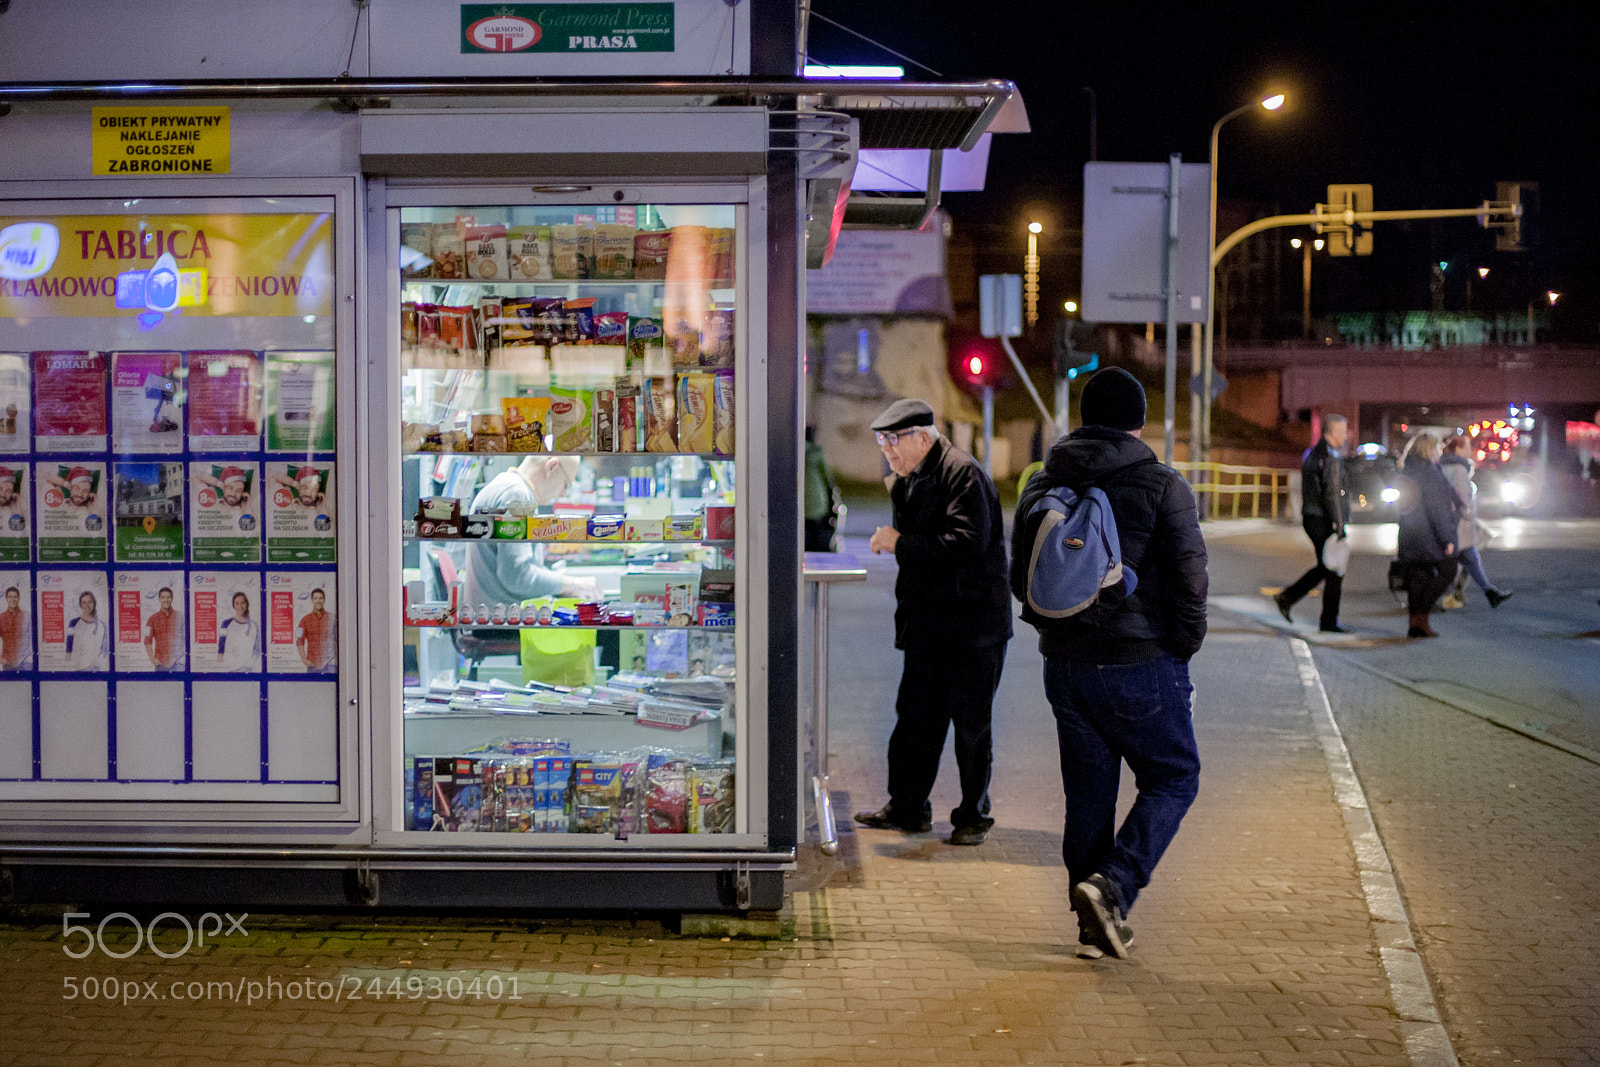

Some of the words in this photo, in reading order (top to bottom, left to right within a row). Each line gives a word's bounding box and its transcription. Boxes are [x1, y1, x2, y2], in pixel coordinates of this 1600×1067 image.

[538, 8, 620, 26] Garmond
[627, 8, 671, 25] Press
[568, 36, 638, 48] PRASA
[99, 117, 147, 128] OBIEKT
[151, 116, 221, 127] PRYWATNY
[120, 130, 201, 141] NAKLEJANIE
[126, 142, 195, 155] OGŁOSZEŃ
[108, 159, 212, 172] ZABRONIONE
[75, 229, 212, 260] TABLICA
[46, 360, 88, 369] LOMAR
[595, 772, 612, 780] CITY
